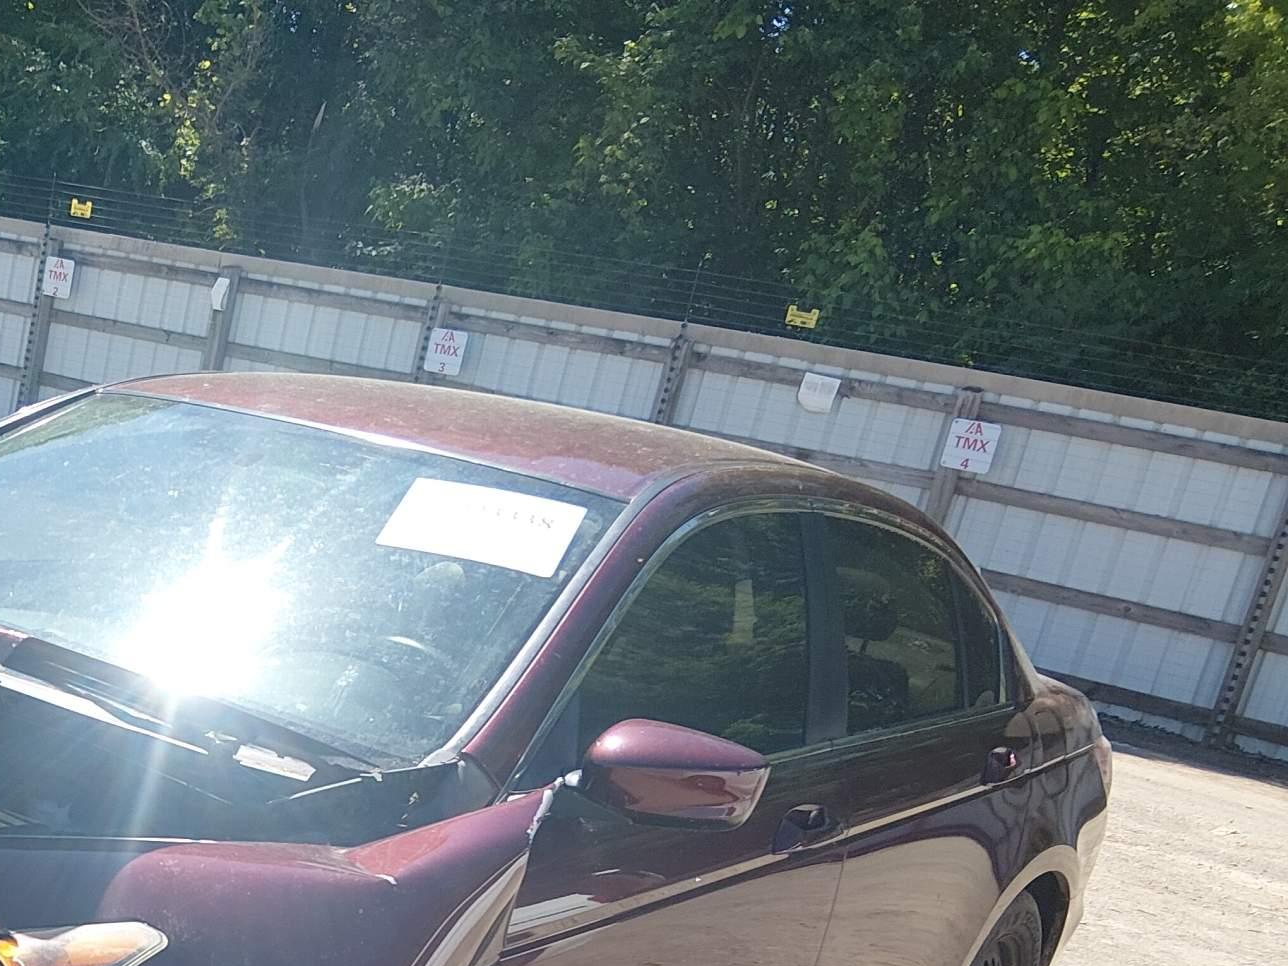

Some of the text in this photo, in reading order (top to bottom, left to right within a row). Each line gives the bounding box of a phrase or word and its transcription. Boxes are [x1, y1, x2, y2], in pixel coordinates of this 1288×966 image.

[48, 269, 69, 283] TMX
[53, 287, 58, 296] 2
[433, 343, 460, 358] TMX
[439, 362, 445, 372] 3
[954, 435, 990, 453] TMX
[960, 458, 969, 470] 4
